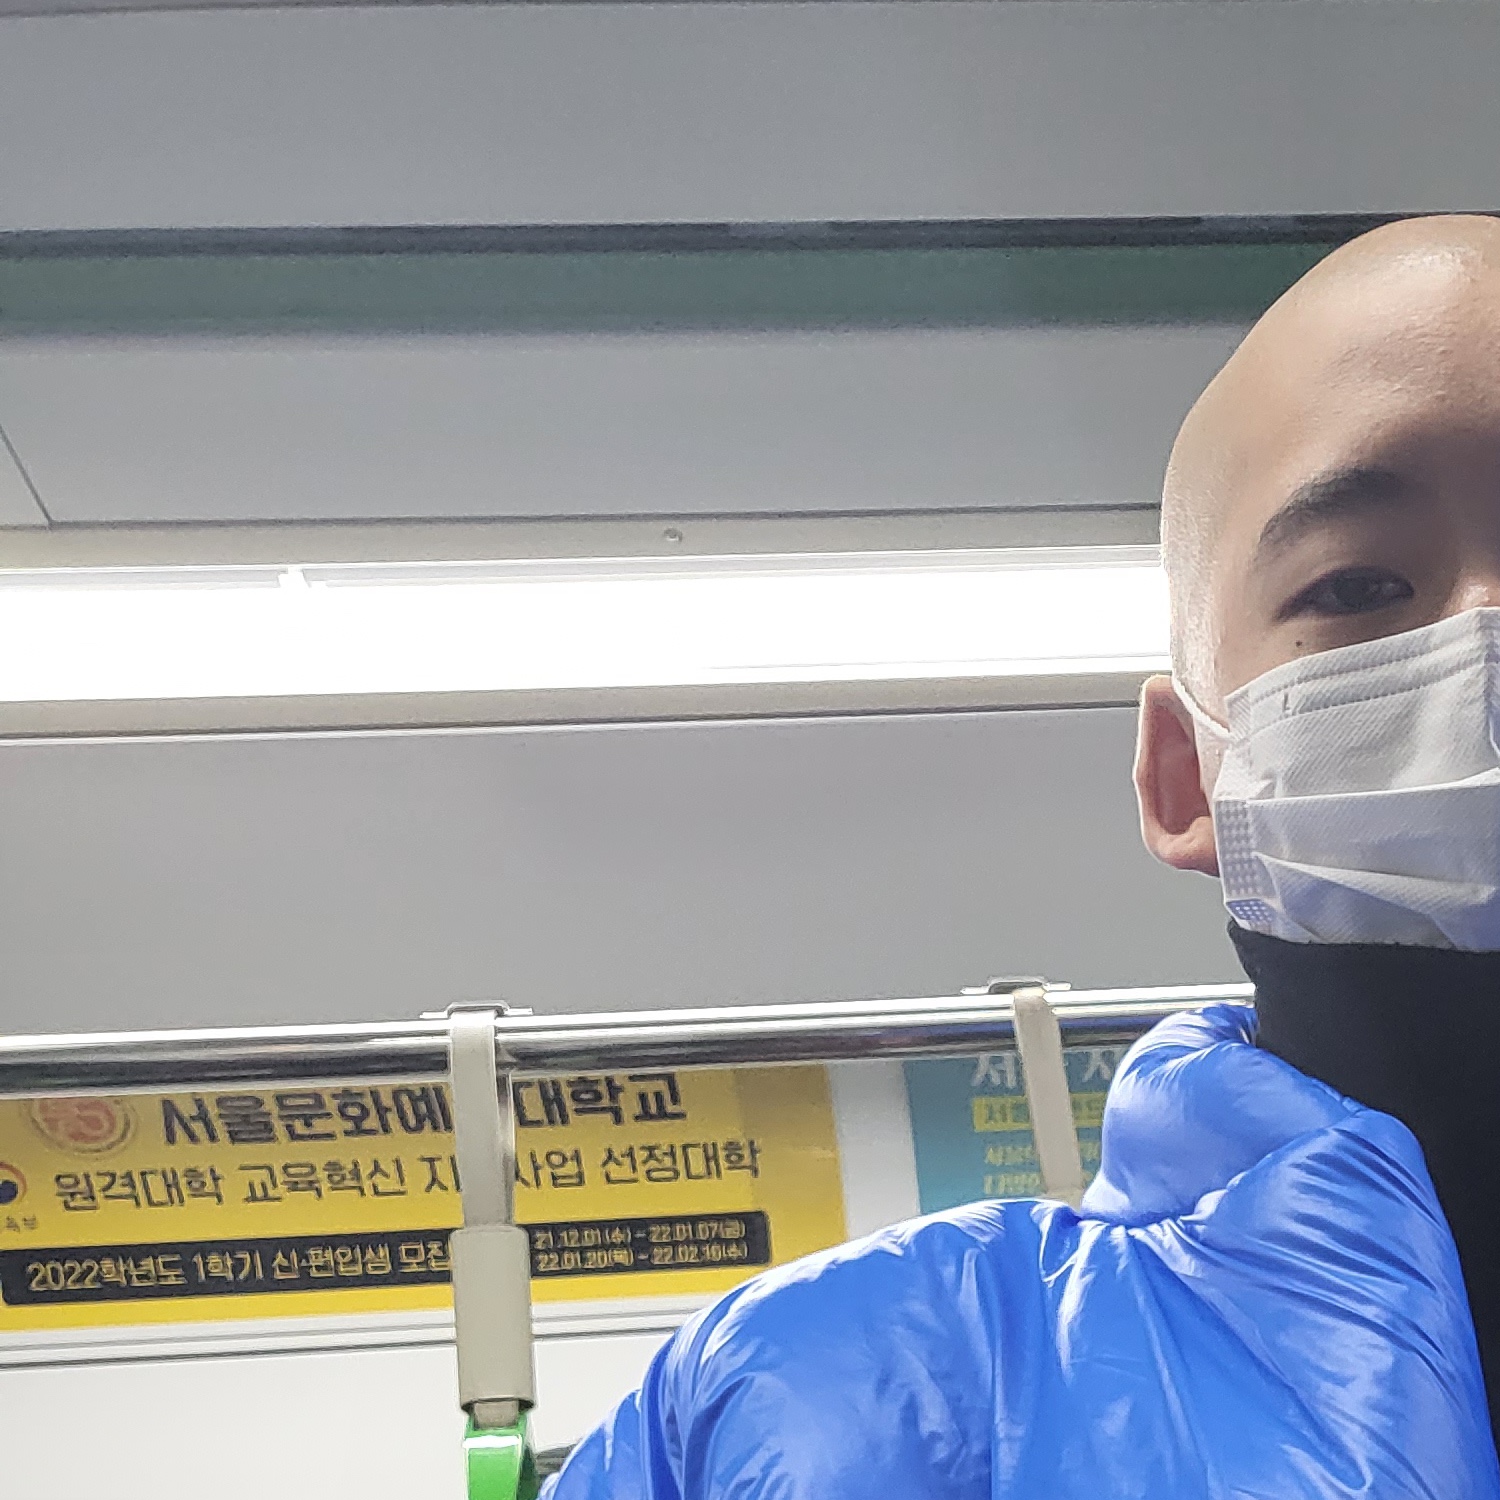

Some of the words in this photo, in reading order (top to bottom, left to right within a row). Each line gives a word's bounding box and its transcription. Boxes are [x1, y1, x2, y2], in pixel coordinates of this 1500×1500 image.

[162, 1072, 687, 1144] 서울문화예대학교
[55, 1165, 224, 1211] 원격대학
[239, 1157, 408, 1203] 교육혁신
[419, 1148, 586, 1193] 지사업
[601, 1139, 761, 1184] 선정대학
[27, 1253, 187, 1291] 2022학년도
[192, 1250, 263, 1283] 1학기
